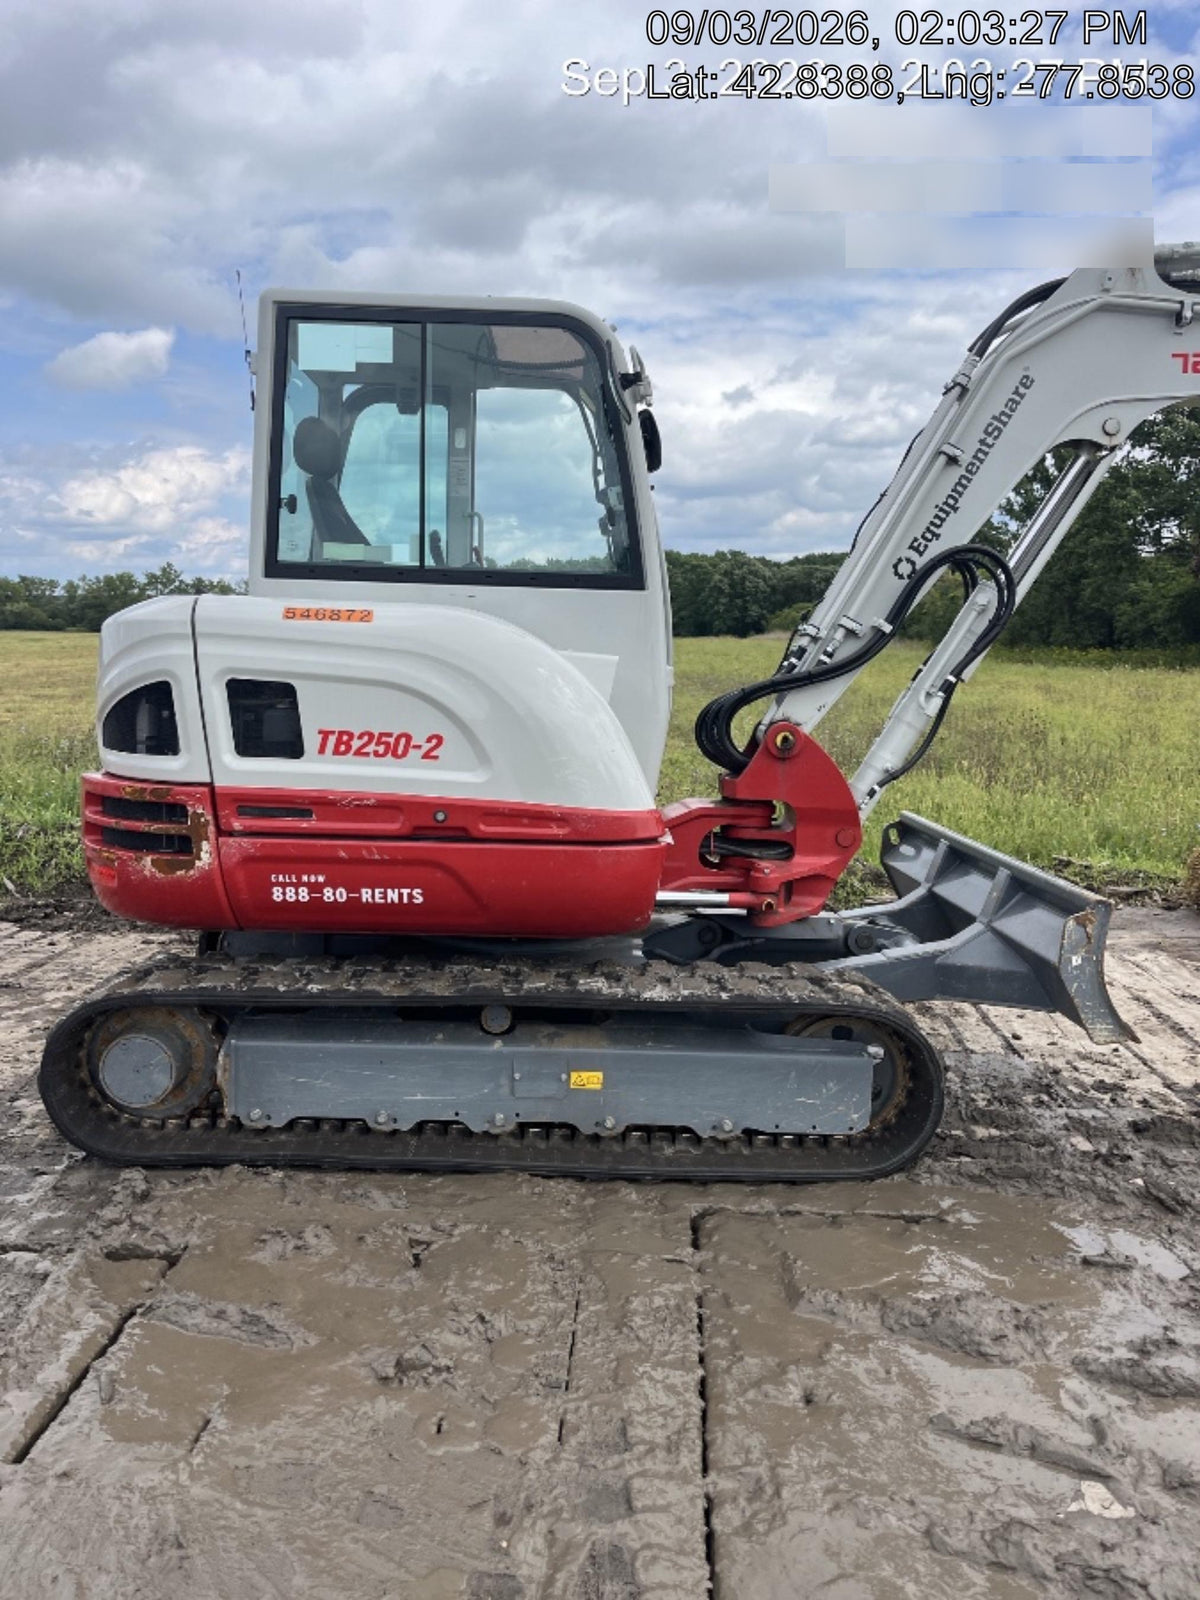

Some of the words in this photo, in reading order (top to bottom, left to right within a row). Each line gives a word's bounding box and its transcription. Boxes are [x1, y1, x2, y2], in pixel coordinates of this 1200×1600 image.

[907, 373, 1036, 559] EquipmentShare
[284, 606, 372, 623] 546872
[317, 729, 444, 761] TB250-2
[271, 874, 298, 883] CALL
[301, 874, 326, 883] NOW
[271, 886, 424, 905] 888-80-RENTS
